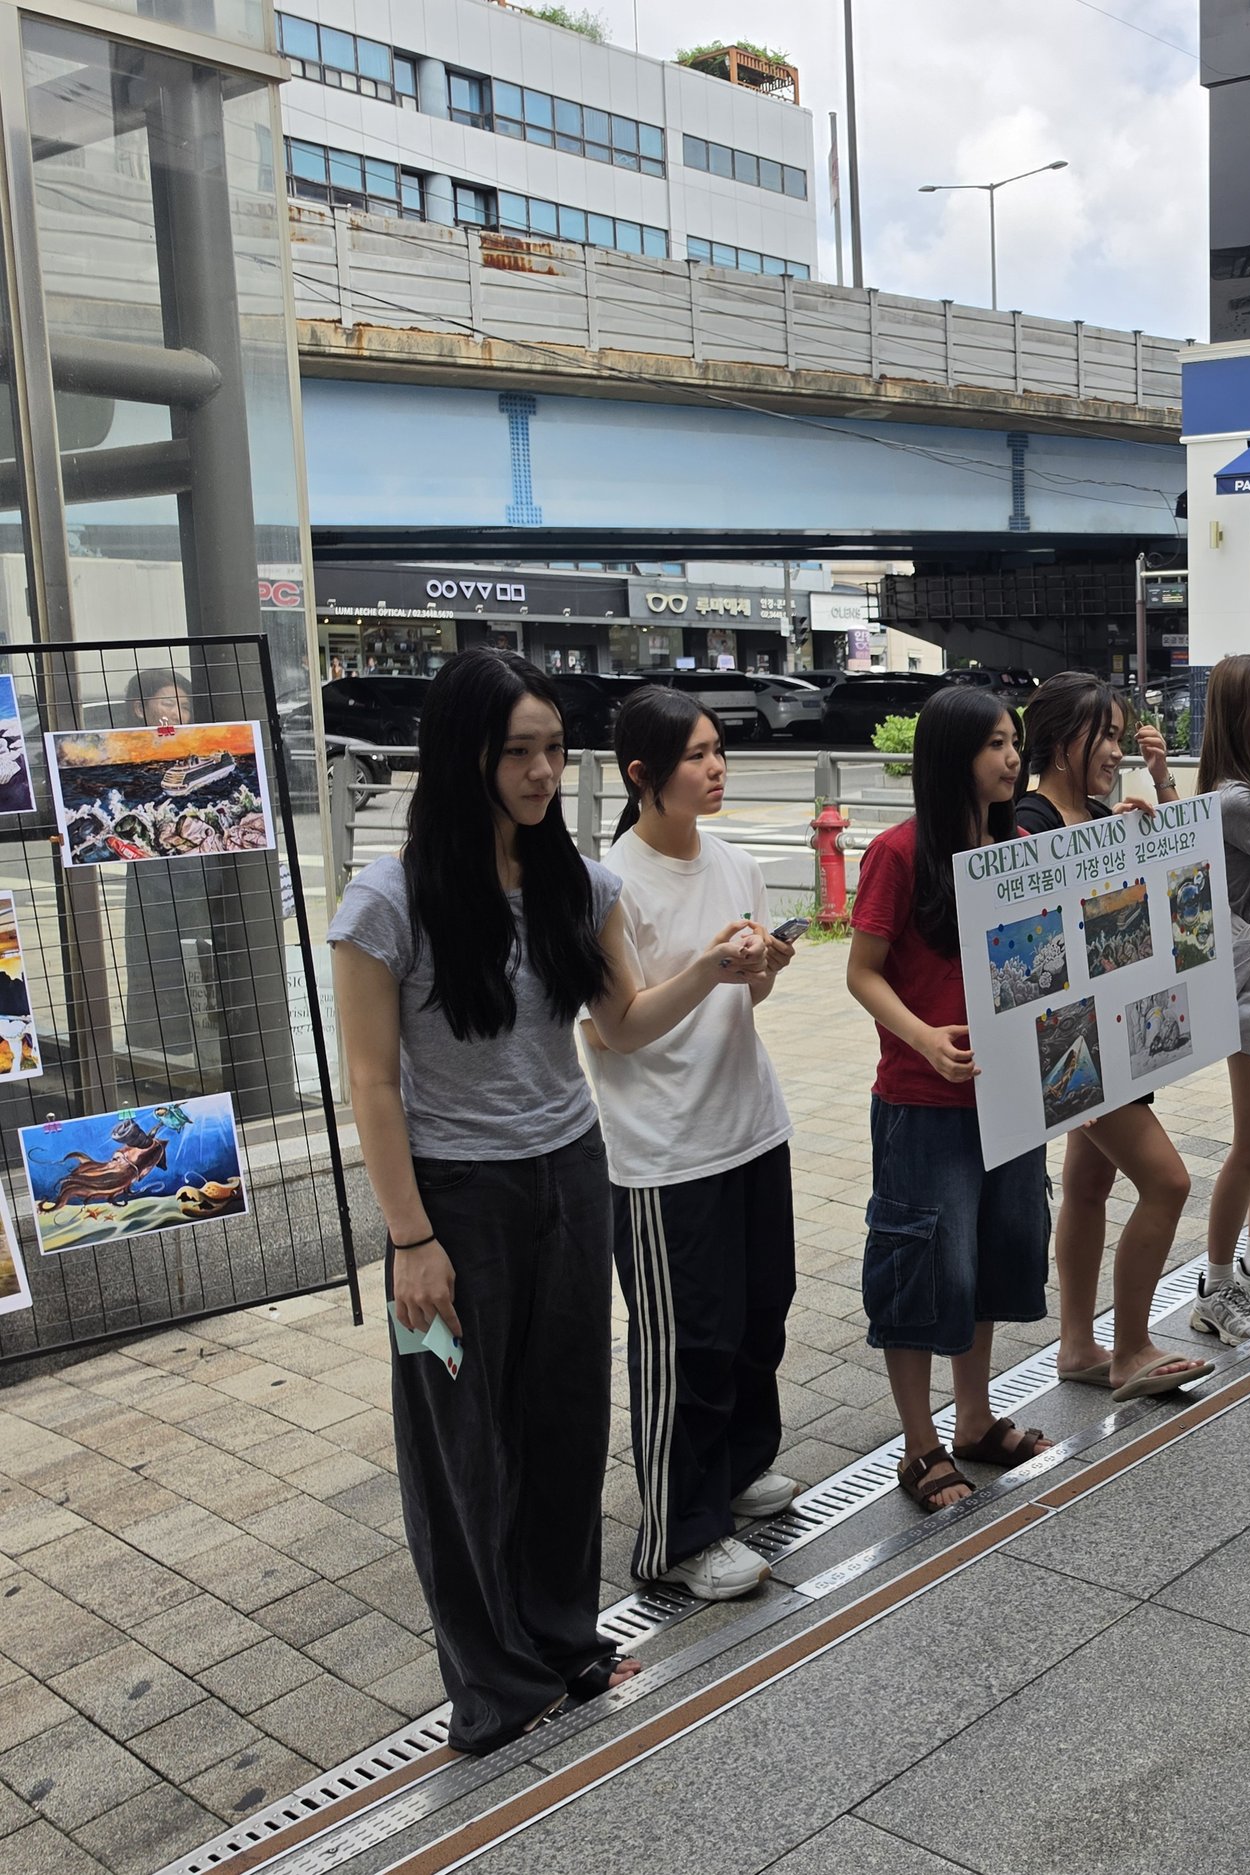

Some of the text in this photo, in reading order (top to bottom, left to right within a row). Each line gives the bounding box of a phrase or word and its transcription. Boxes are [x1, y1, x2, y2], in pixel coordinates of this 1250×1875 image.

[335, 606, 354, 616] LUMI
[378, 608, 407, 618] OPTICAL
[968, 797, 1213, 880] GREEN CANVAS SOCIETY
[997, 832, 1196, 903] 어떤 작품이 가장 인상 깊으셨나요?
